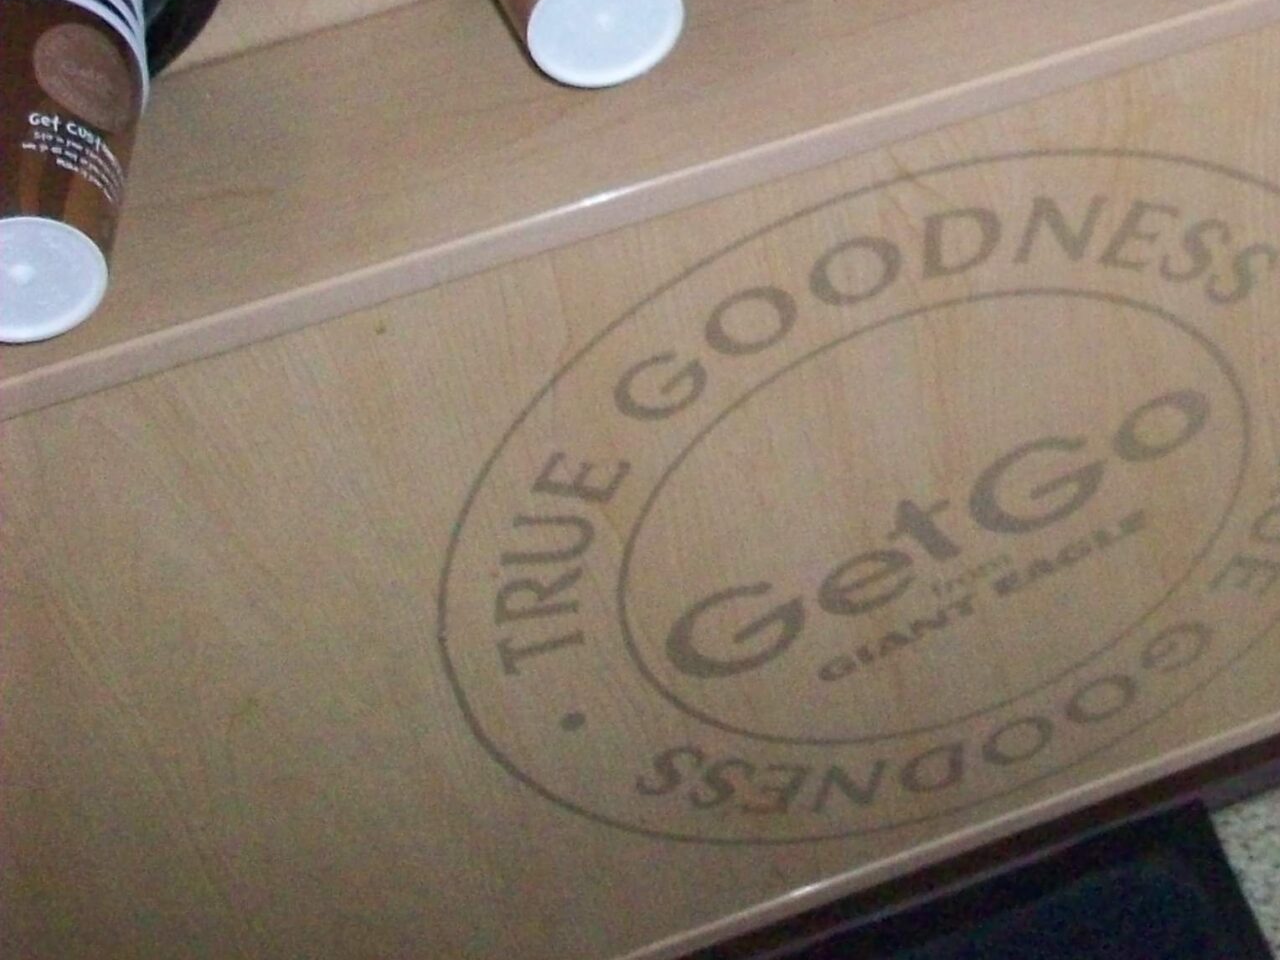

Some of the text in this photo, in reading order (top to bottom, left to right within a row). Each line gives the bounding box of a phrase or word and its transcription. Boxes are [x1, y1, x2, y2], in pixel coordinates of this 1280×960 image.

[493, 195, 1280, 678] TRUE GOODNESS
[665, 389, 1212, 679] GetGo
[635, 620, 1212, 817] GOODNESS
[817, 592, 976, 682] GIANT
